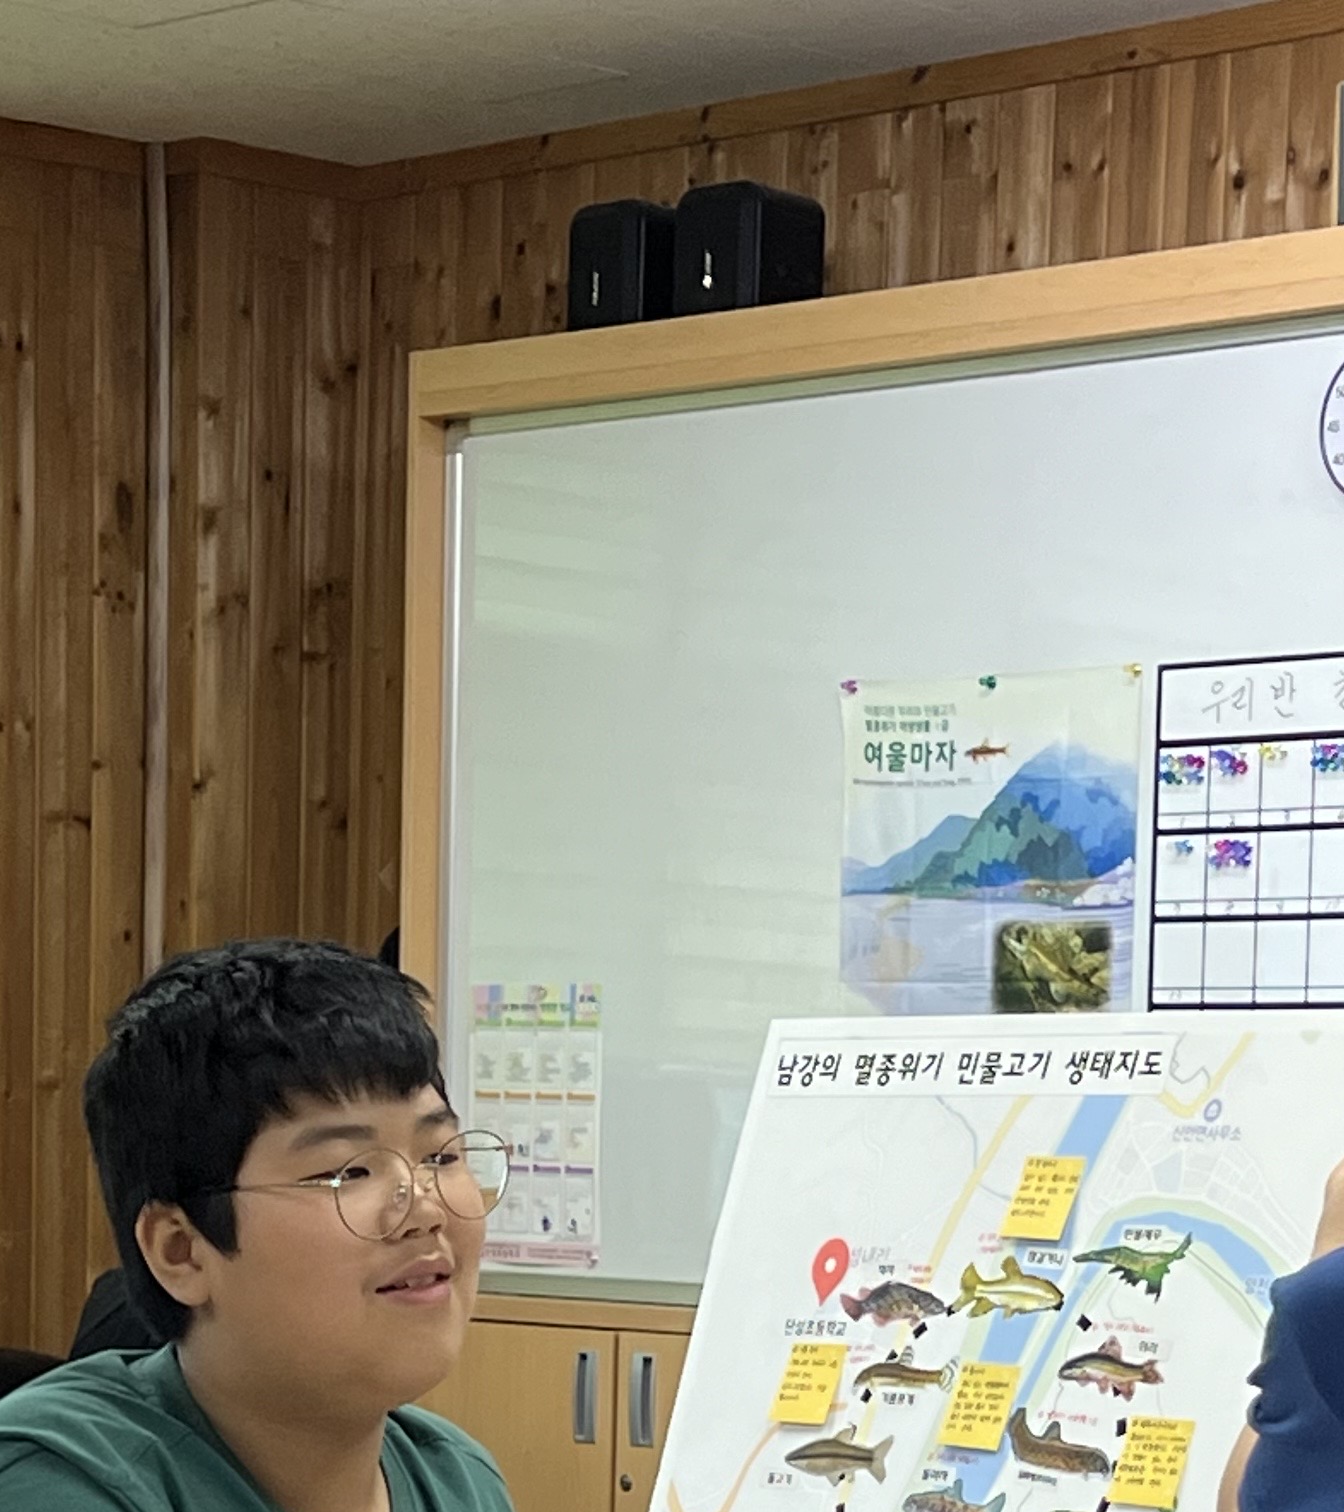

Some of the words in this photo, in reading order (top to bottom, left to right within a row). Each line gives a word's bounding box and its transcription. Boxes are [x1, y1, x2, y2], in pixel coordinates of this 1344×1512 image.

[1327, 419, 1340, 433] 45
[1202, 677, 1254, 724] 우리
[1270, 671, 1296, 718] 반
[863, 739, 957, 772] 여울마자
[777, 1052, 842, 1087] 남강의
[854, 1051, 945, 1087] 멸종위기
[956, 1050, 1052, 1086] 민물고기
[1064, 1050, 1163, 1086] 생태지도
